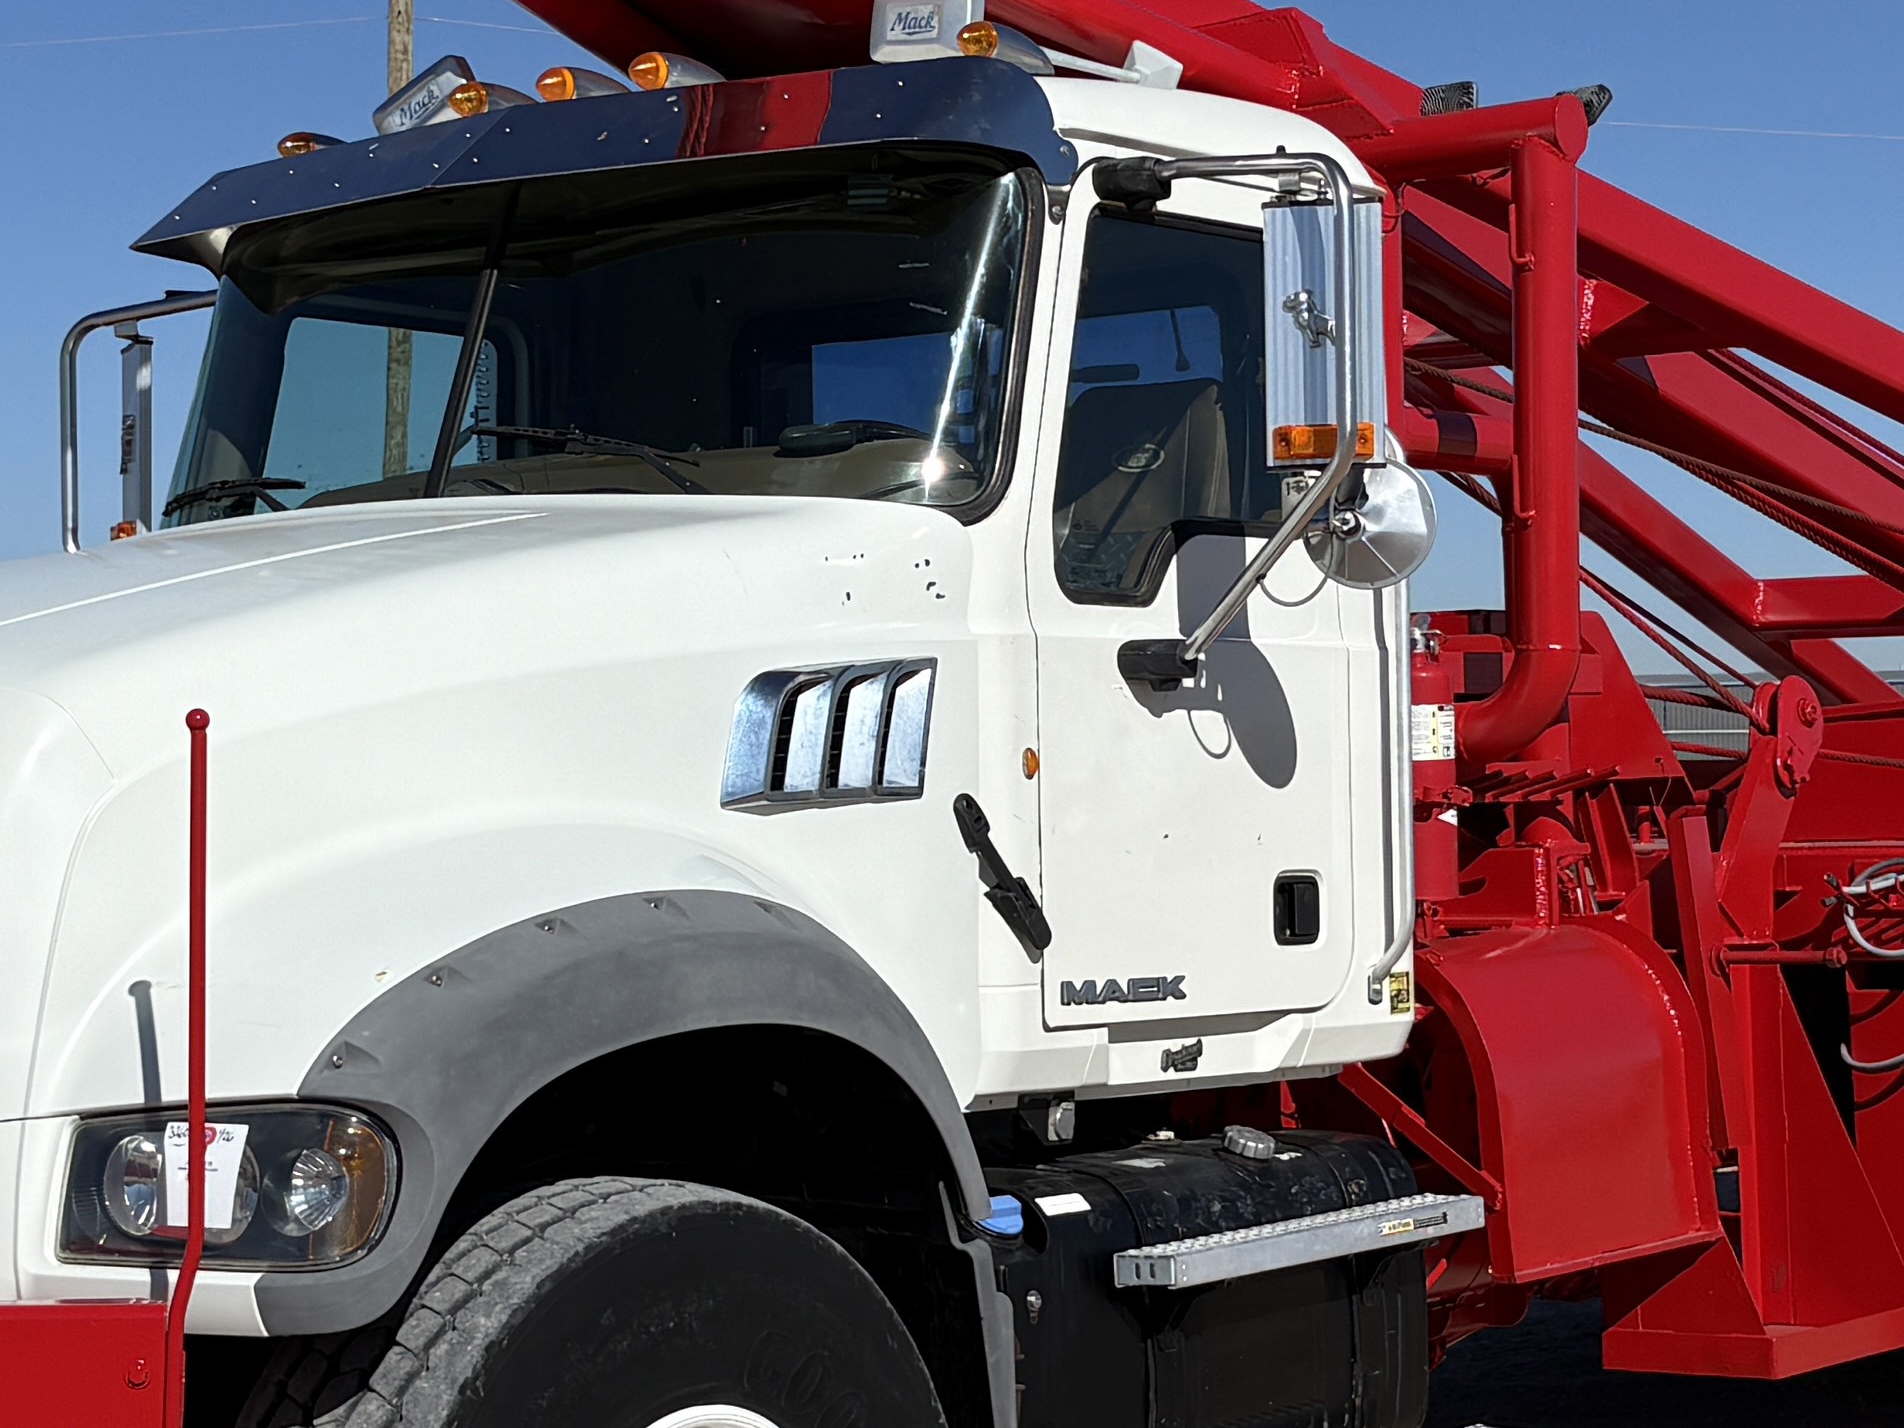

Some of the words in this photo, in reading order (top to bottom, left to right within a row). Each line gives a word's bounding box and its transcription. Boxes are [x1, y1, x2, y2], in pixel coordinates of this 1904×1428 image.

[890, 12, 936, 36] Mack
[398, 85, 439, 126] Mack
[1060, 975, 1187, 1006] MACK
